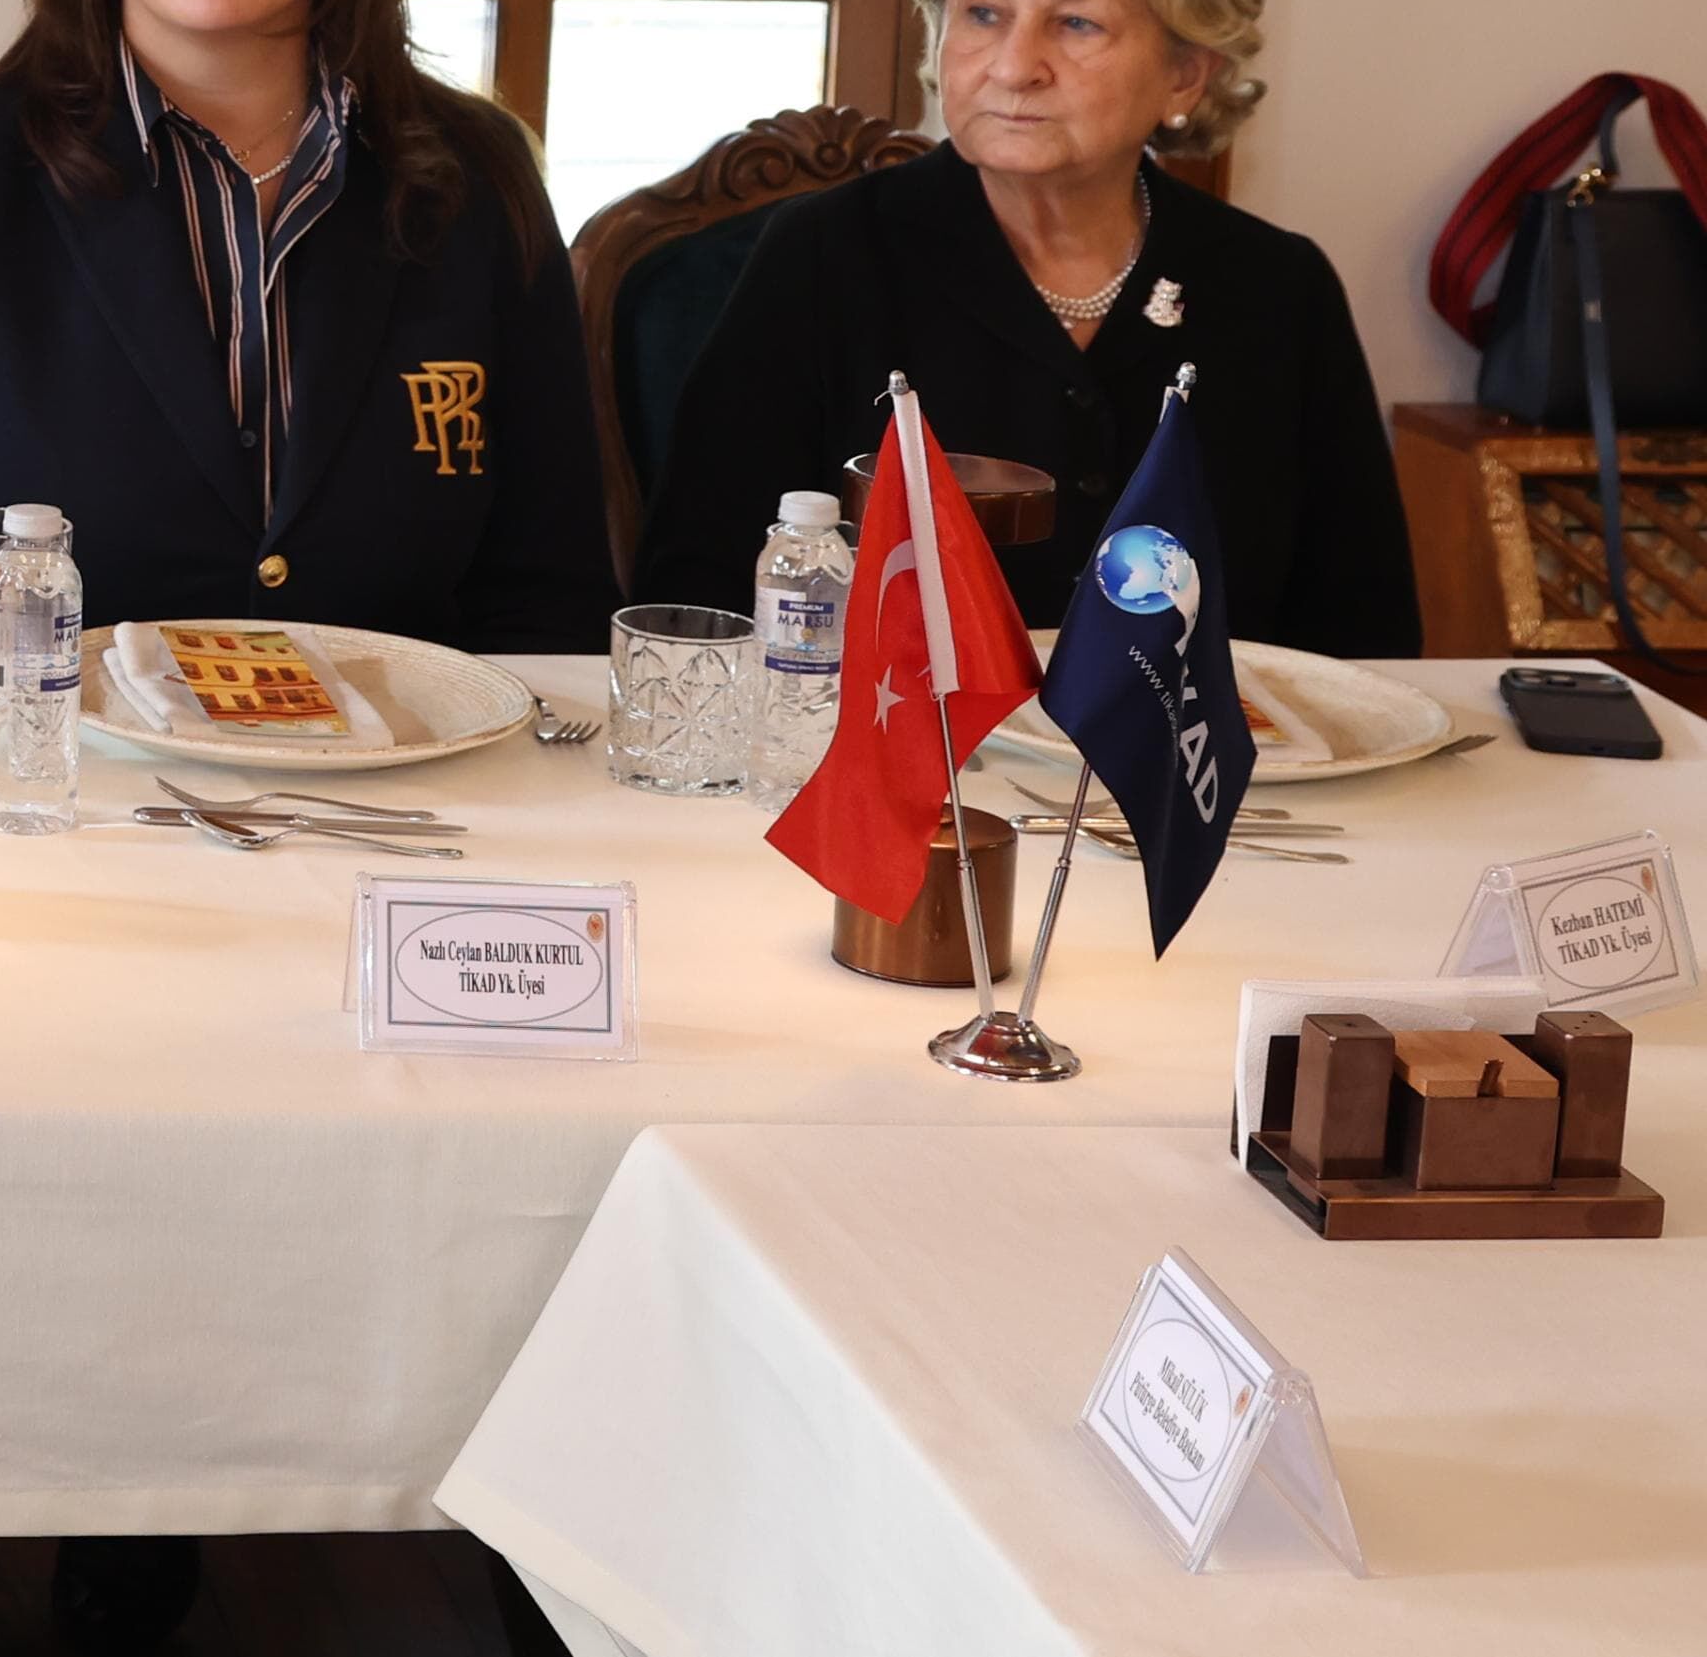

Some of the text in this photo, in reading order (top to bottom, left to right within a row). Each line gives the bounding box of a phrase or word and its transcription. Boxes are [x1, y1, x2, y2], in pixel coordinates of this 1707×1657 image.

[777, 613, 834, 628] MARSU
[1550, 892, 1646, 936] Kezban HATEMİ
[419, 940, 584, 966] Nazlı Ceylan BALDUK KURTUL
[1557, 937, 1600, 965] TİKAD
[1621, 925, 1653, 953] Üyesi
[459, 967, 545, 1000] TİKAD Yk. Üyesi
